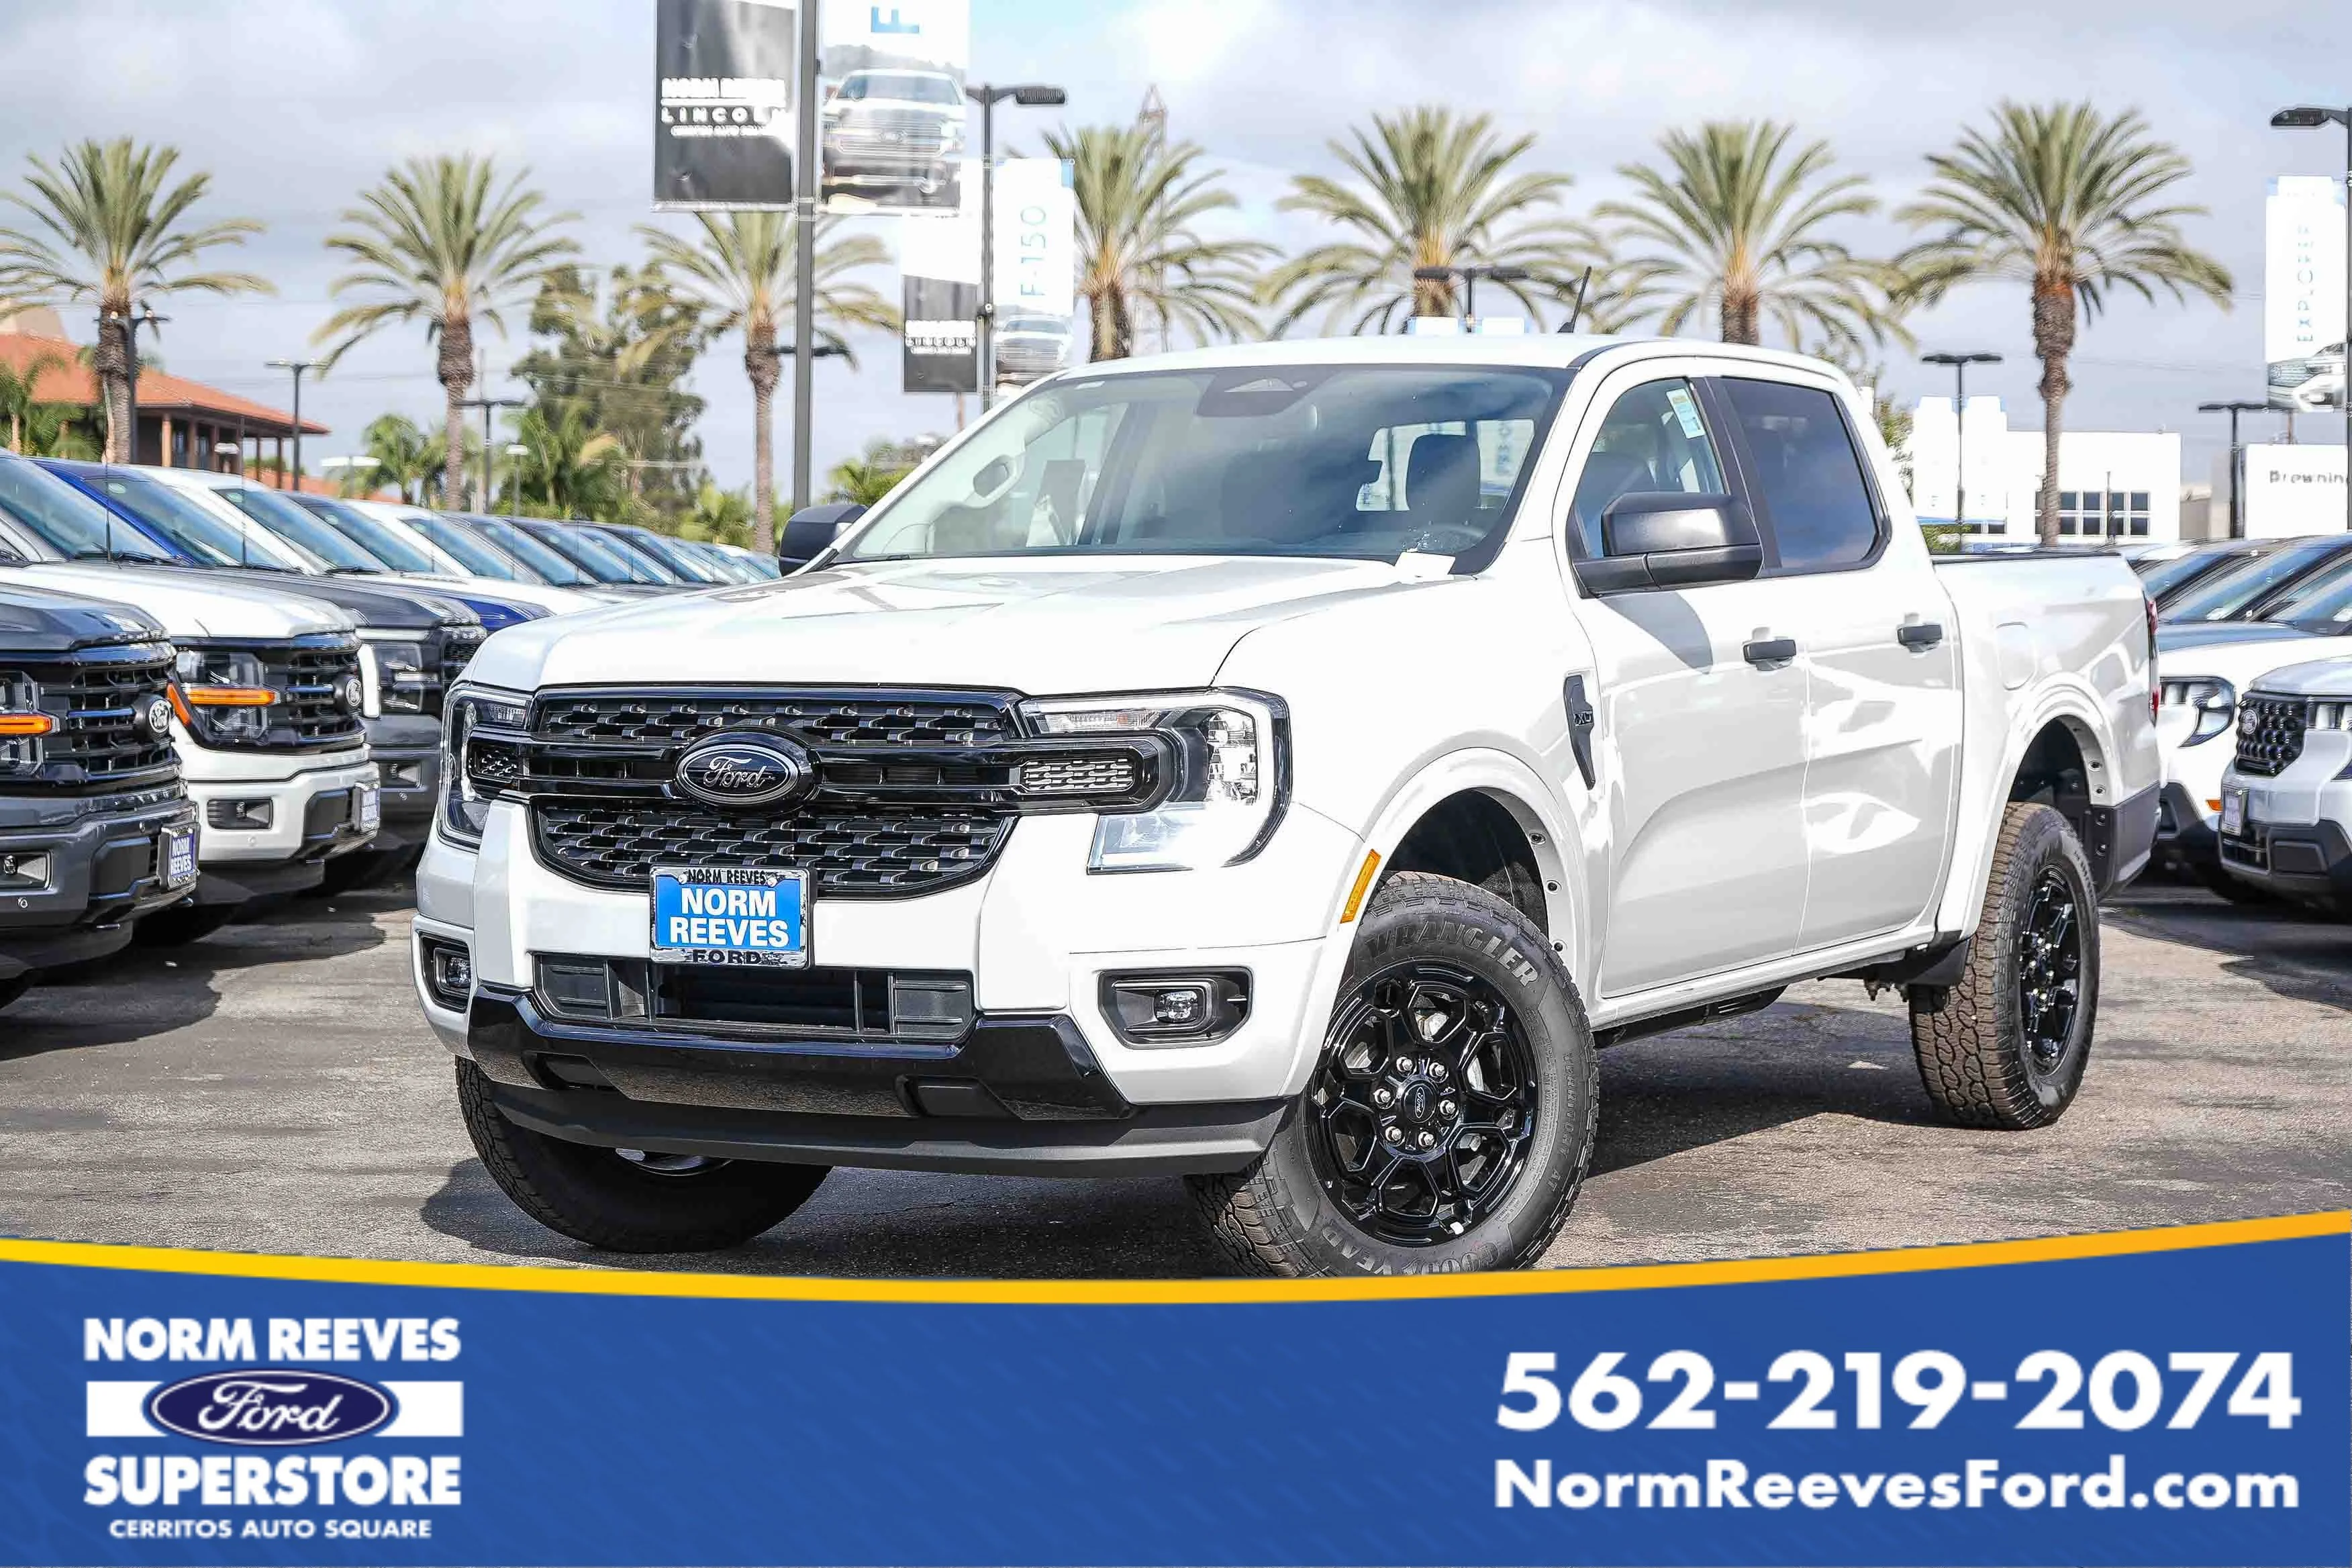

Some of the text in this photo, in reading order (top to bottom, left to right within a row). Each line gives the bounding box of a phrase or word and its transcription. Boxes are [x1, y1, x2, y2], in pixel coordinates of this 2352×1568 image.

[1020, 205, 1046, 296] F-150
[2269, 470, 2348, 485] Brownin
[703, 756, 768, 788] Ford
[687, 869, 767, 885] NORM REEVES
[681, 887, 777, 918] NORM
[670, 916, 789, 948] REEVES
[693, 949, 762, 965] FORD
[1364, 920, 1539, 987] WRANGLER
